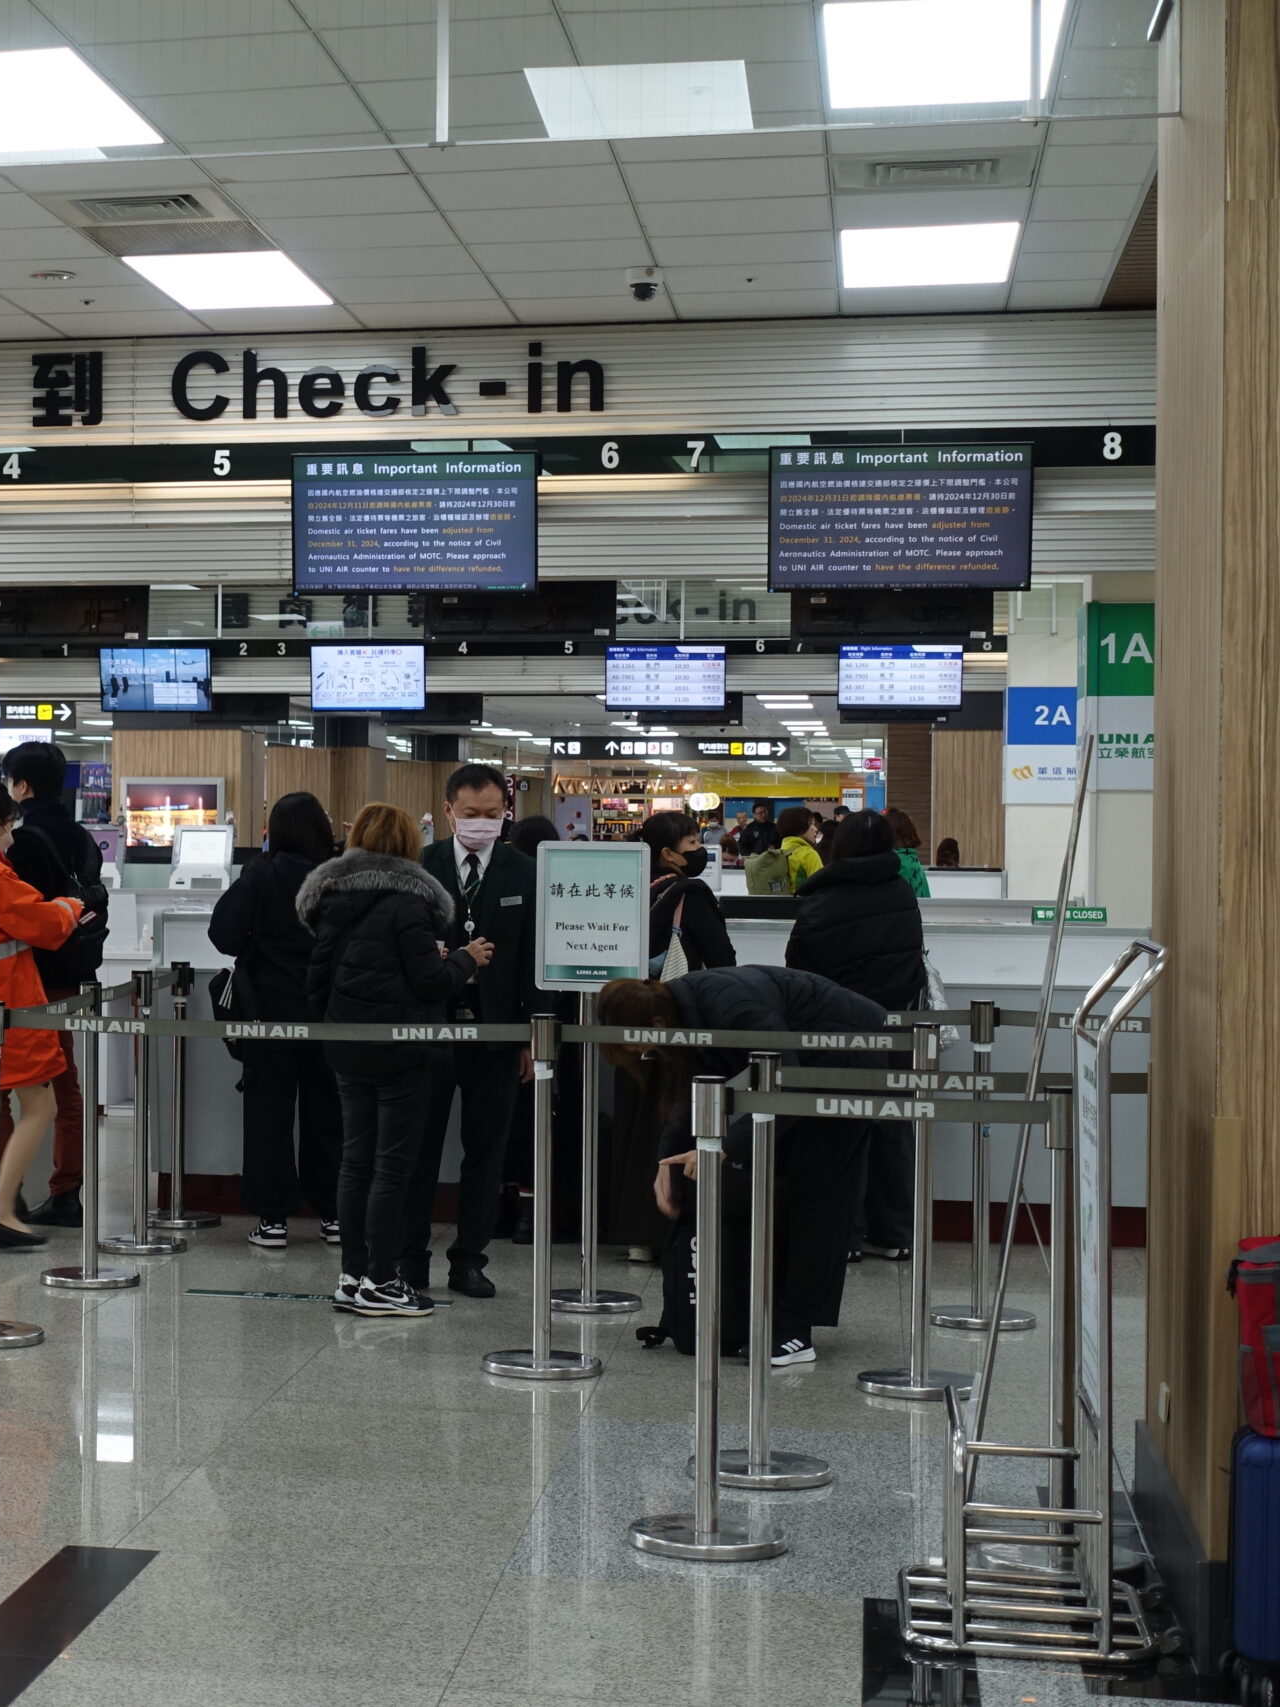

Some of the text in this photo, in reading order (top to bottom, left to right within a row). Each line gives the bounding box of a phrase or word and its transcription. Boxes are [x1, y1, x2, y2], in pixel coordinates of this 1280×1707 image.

[171, 342, 604, 421] Check-in
[1103, 432, 1122, 460] 8
[601, 442, 619, 468] 6
[686, 440, 705, 467] 7
[780, 450, 1023, 466] 重要訊息 Important Information
[3, 454, 21, 479] 4
[213, 450, 231, 475] 5
[306, 461, 522, 477] 重要訊息 Important Information
[780, 521, 990, 531] Domestic air ticket fares have been adjusted from
[779, 535, 819, 545] December
[865, 535, 904, 545] according
[909, 535, 917, 545] to
[921, 535, 934, 545] the
[938, 535, 964, 545] notice
[967, 535, 977, 545] of
[980, 535, 998, 545] Civil
[779, 549, 1003, 558] Aeronautics Administration of MOTC. Please approach
[779, 563, 787, 571] to
[791, 563, 806, 571] UNI
[810, 563, 824, 571] AIR
[828, 563, 858, 571] counter
[862, 563, 871, 571] to
[875, 563, 894, 571] have
[898, 563, 911, 571] the
[915, 563, 956, 571] difference
[62, 643, 69, 656] 1
[239, 642, 248, 655] 2
[277, 642, 286, 655] 3
[458, 641, 468, 654] 4
[564, 640, 573, 654] 5
[756, 640, 765, 652] 6
[1100, 632, 1154, 664] 1A
[1034, 705, 1072, 726] 2A
[1099, 734, 1139, 744] UNI
[550, 883, 635, 899] 請在此等候
[1072, 910, 1103, 920] CLOSED
[555, 921, 630, 932] Please Wait For
[566, 941, 618, 952] Next Agent
[64, 1018, 146, 1034] UNI AIR
[1059, 1017, 1099, 1030] UI
[225, 1024, 309, 1039] UNI AIR
[392, 1027, 478, 1041] UNI AIR
[623, 1030, 713, 1045] UNI AIR
[801, 1035, 893, 1049] UNI AIR
[887, 1073, 995, 1091] UNI AIR
[816, 1099, 936, 1118] UNI AIR
